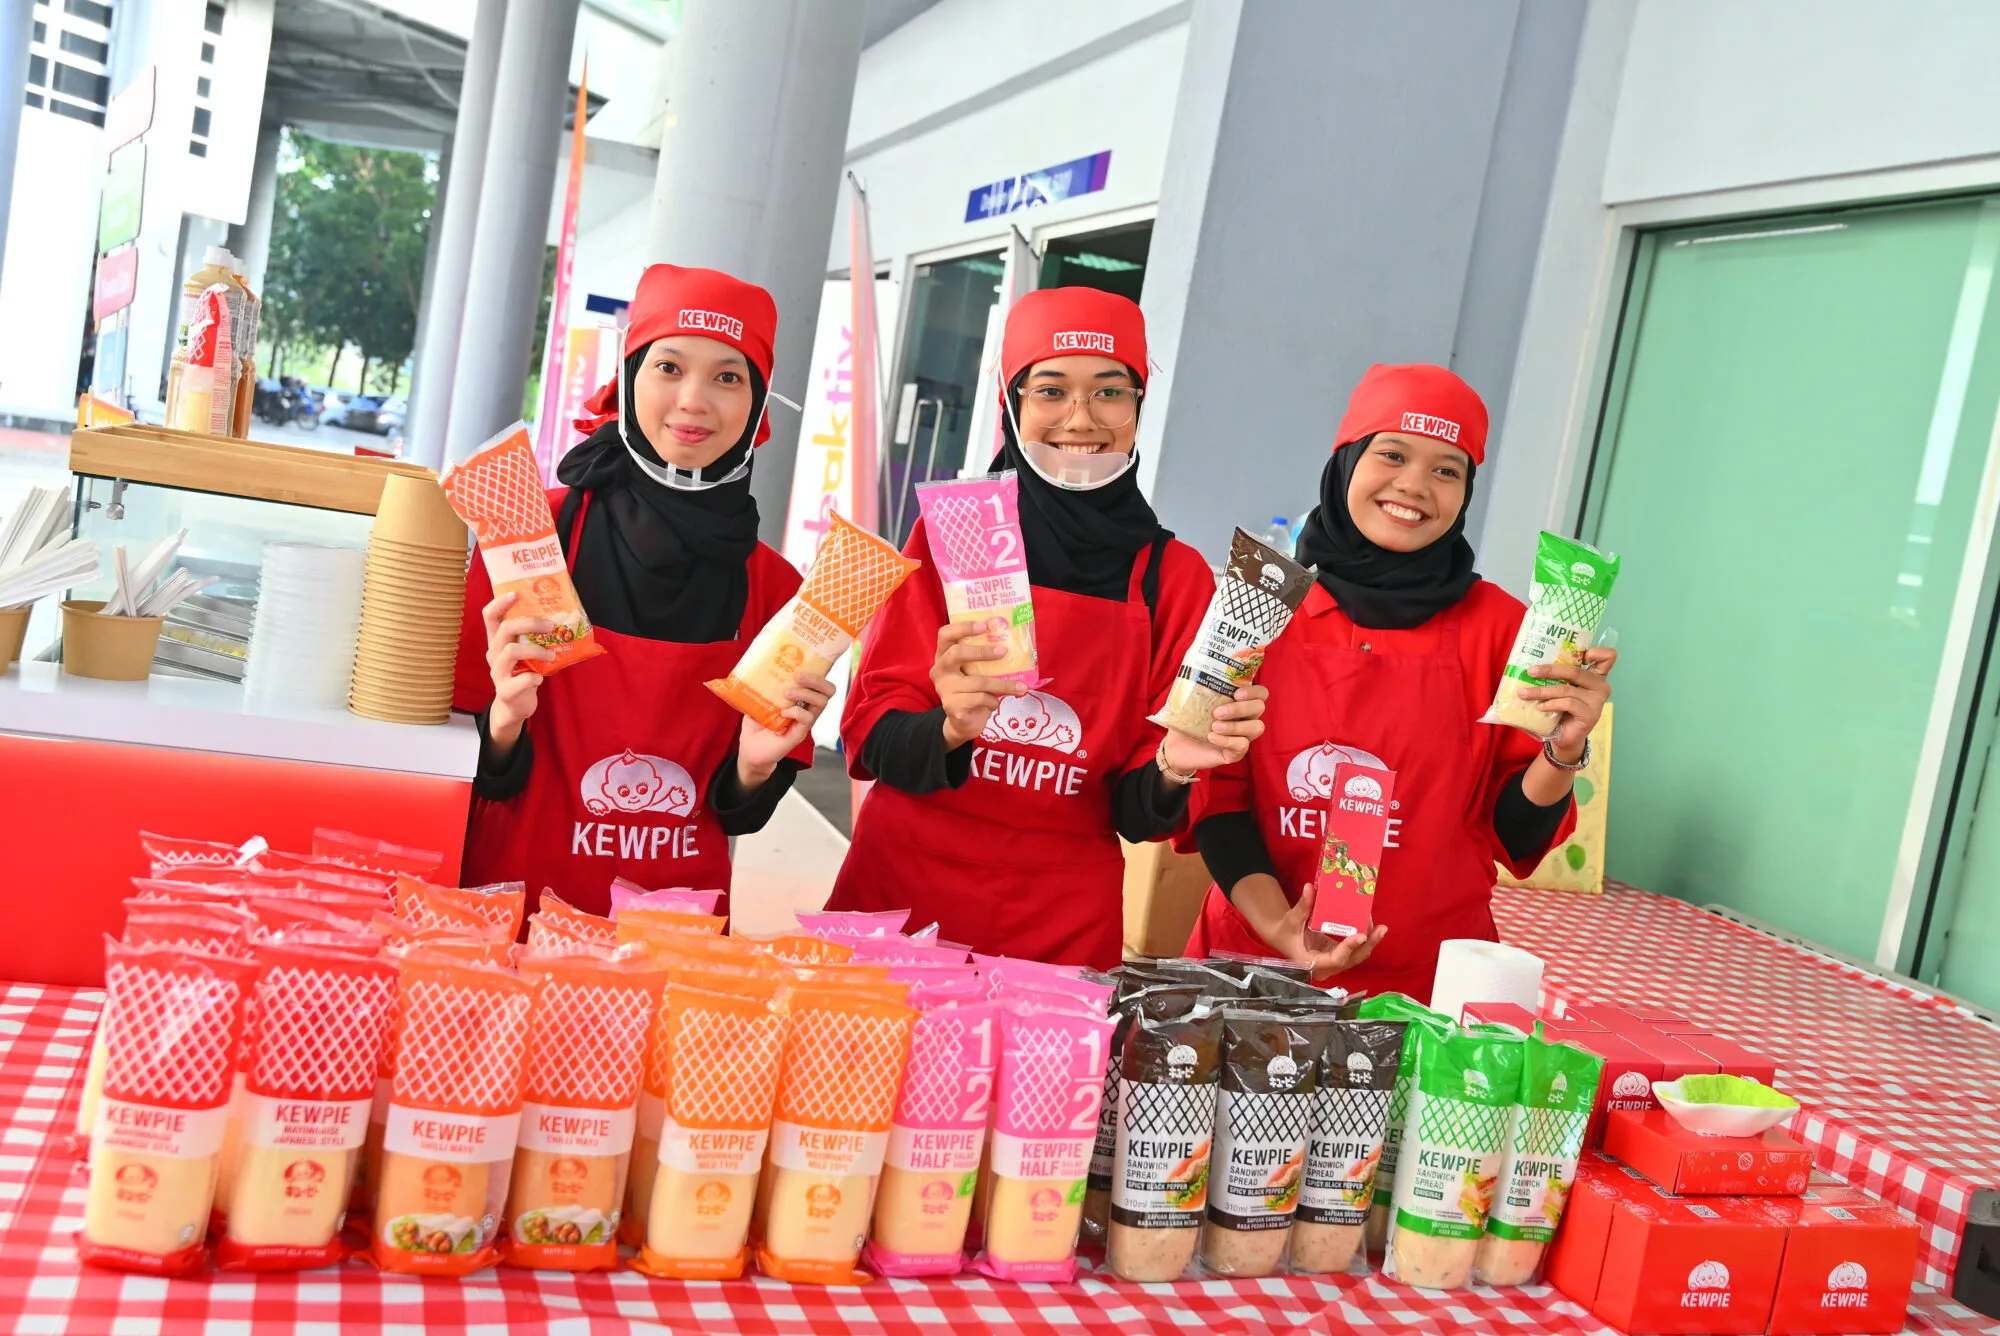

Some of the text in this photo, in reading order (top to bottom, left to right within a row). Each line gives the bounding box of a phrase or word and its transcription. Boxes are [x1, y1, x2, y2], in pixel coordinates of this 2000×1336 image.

[680, 309, 743, 340] KEWPIE
[1054, 331, 1114, 353] KEWPIE
[1401, 412, 1460, 442] KEWPIE
[512, 543, 560, 564] KEWPIE
[965, 577, 1013, 596] KEWPIE
[967, 594, 998, 609] HALF
[794, 602, 840, 641] KEWPIE
[970, 747, 1088, 795] KEWPIE
[1339, 797, 1385, 817] KEWPIE
[1279, 806, 1402, 848] KEE
[571, 821, 699, 860] KEWPIE
[107, 1105, 187, 1132] KEWPIE
[275, 1104, 352, 1124] KEWPIE
[412, 1120, 487, 1144] KEWPIE
[539, 1115, 610, 1137] KEWPIE
[547, 1134, 600, 1147] CHILLI MAYO
[689, 1134, 756, 1151] KEWPIE
[798, 1130, 866, 1153] KEWPIE
[913, 1133, 975, 1150] KEWPIE
[1128, 1139, 1194, 1159] KEWPIE
[1022, 1143, 1083, 1158] KEWPIE
[1231, 1147, 1292, 1165] KEWPIE
[1309, 1139, 1370, 1160] KEWPIE
[910, 1152, 952, 1169] HALF
[1019, 1160, 1059, 1177] HALF
[1127, 1159, 1168, 1171] SANDWICH
[1308, 1158, 1344, 1170] SANDWICH
[1418, 1149, 1482, 1175] KEWPIE
[1126, 1168, 1158, 1180] SPREAD
[1230, 1165, 1268, 1177] SANDWICH
[1306, 1168, 1334, 1179] SPREAD
[1416, 1168, 1455, 1182] SANDWICH
[1514, 1160, 1562, 1180] KEWPIE
[1127, 1181, 1146, 1190] SPICY
[1166, 1183, 1188, 1191] PEPPER
[1229, 1175, 1258, 1186] SPREAD
[1306, 1179, 1364, 1191] SPICY BLACK PEPPER
[1415, 1178, 1444, 1190] SPREAD
[1229, 1186, 1285, 1196] SPICY BLACK PEPPER
[1681, 1292, 1731, 1308] KEWPIE
[1821, 1292, 1869, 1308] KEWPIE
